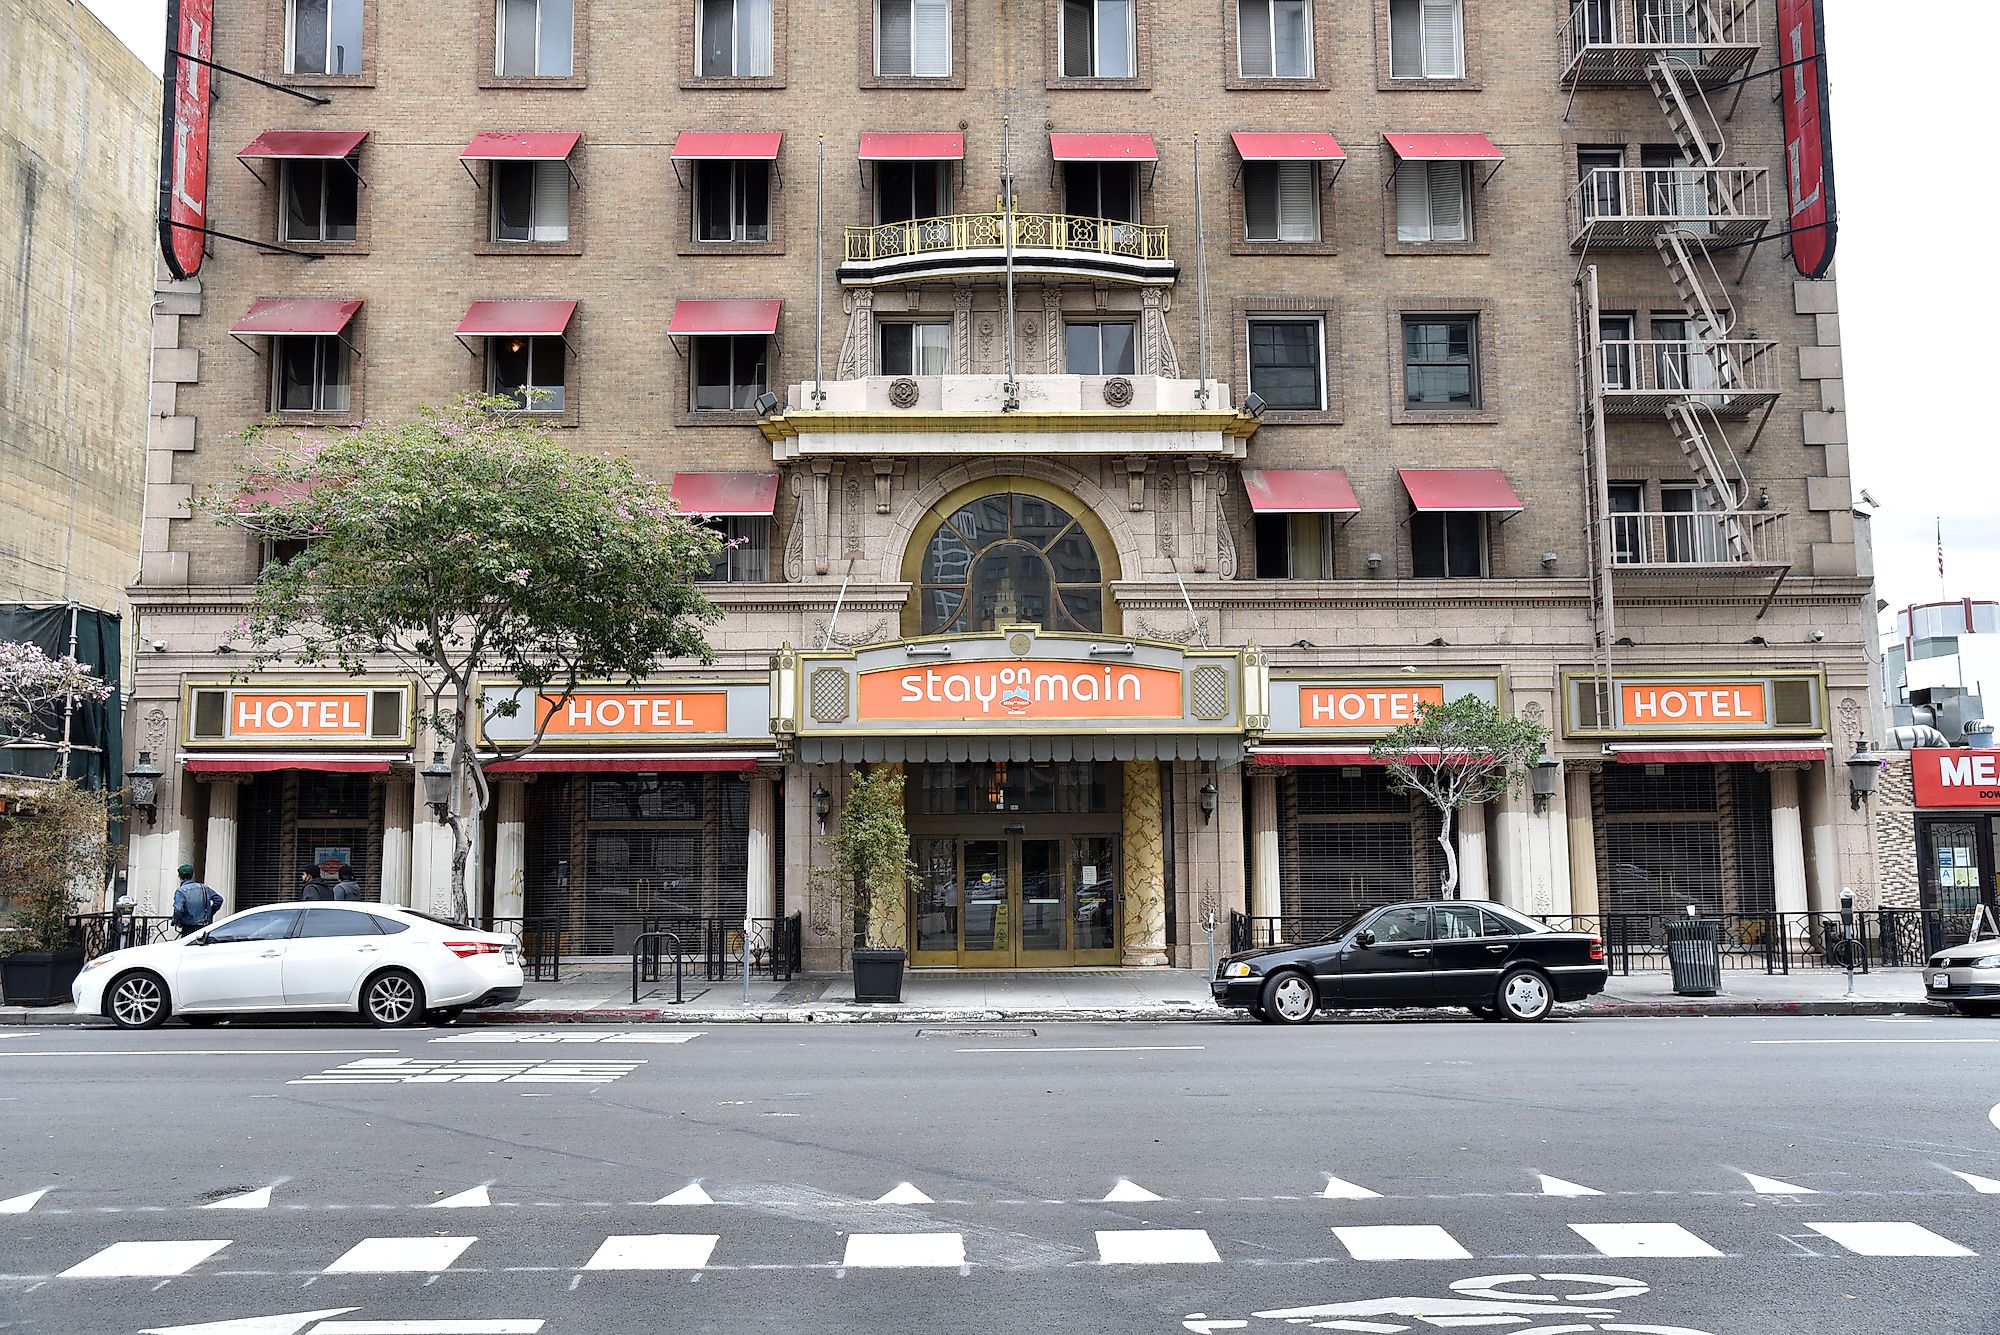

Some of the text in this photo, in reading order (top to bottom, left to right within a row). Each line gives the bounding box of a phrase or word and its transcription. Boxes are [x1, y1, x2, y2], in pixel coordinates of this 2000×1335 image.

[901, 666, 1142, 713] stay on main
[1634, 690, 1752, 718] HOTEL
[238, 700, 361, 729] HOTEL
[567, 698, 694, 727] HOTEL
[1312, 692, 1427, 720] HOTEL
[1939, 755, 2000, 787] ME
